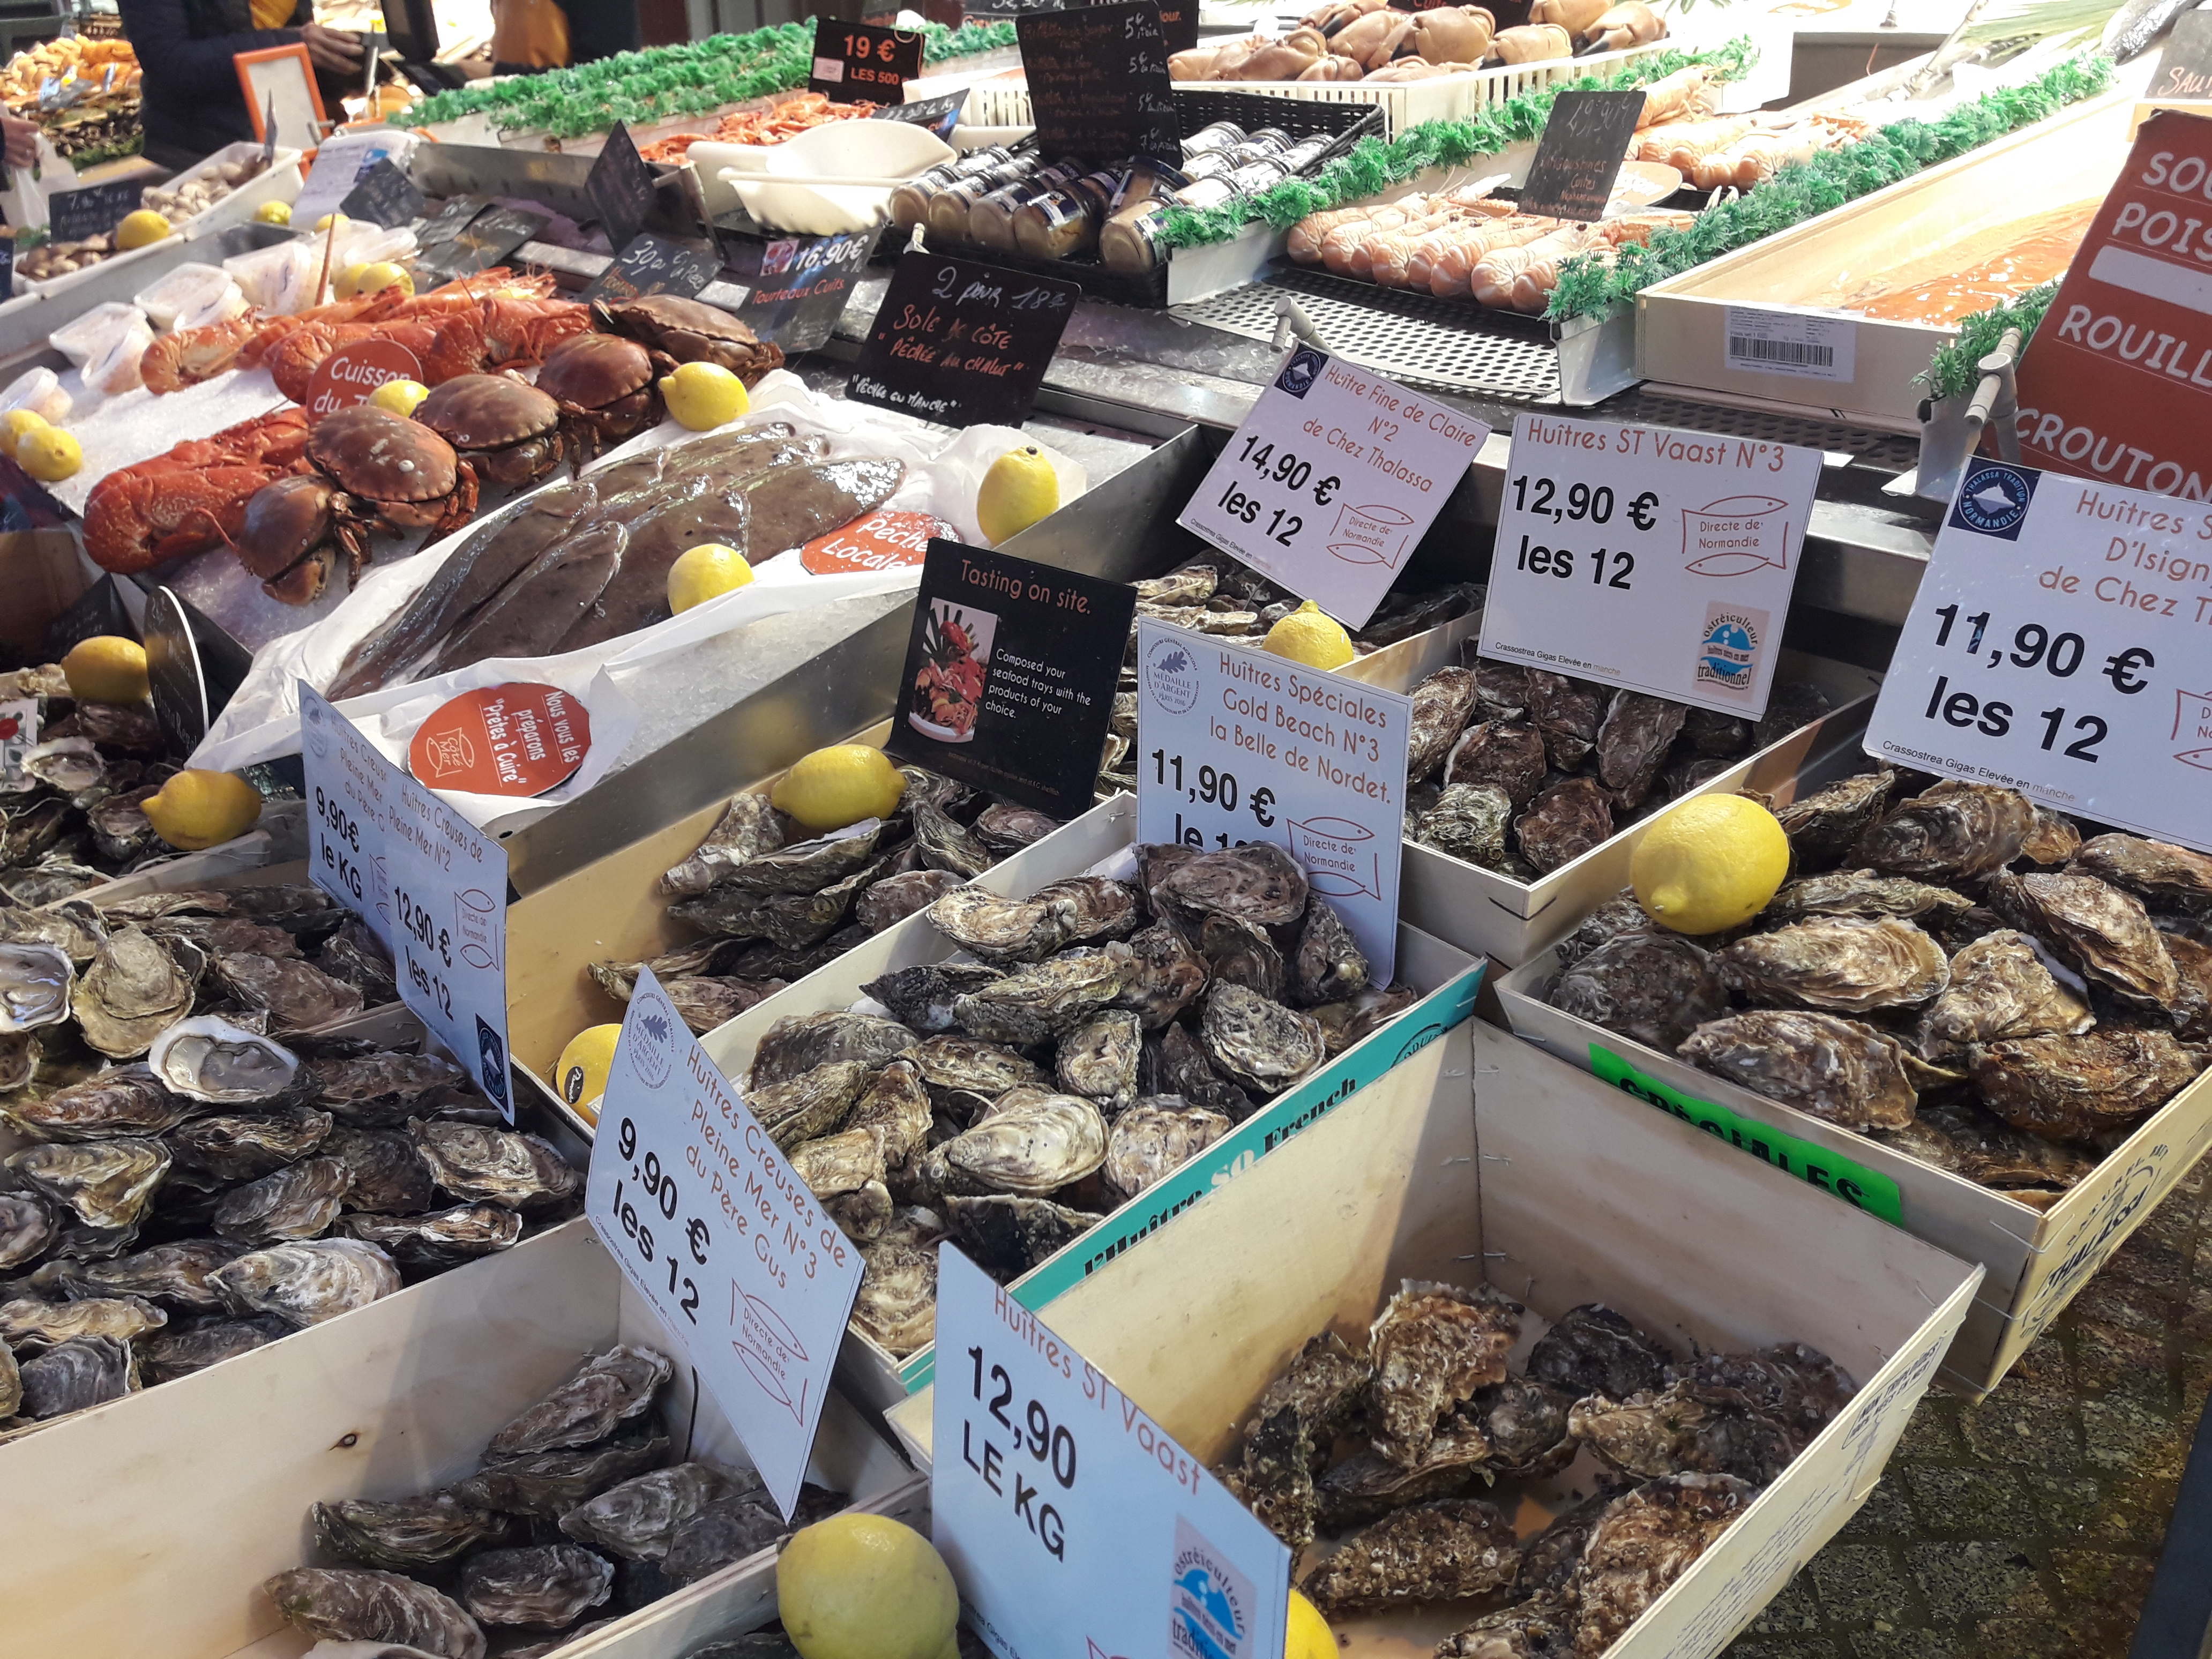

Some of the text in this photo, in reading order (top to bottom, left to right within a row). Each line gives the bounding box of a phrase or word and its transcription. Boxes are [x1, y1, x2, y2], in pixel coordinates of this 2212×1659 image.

[844, 34, 896, 62] 19 €
[850, 67, 900, 86] LES 500
[795, 235, 869, 272] 16,90€
[814, 278, 845, 295] Cuits
[932, 266, 958, 299] 2
[314, 388, 341, 413] du
[1325, 364, 1363, 396] Huître
[1368, 385, 1400, 412] Fine
[1402, 402, 1424, 424] de
[1429, 412, 1477, 447] Claire
[1302, 418, 1433, 492] de Chez Thalassa
[1367, 415, 1399, 443] N°2
[1527, 417, 1785, 473] Huîtres ST Vaast N°3
[1239, 435, 1340, 506] 14,90 €
[1966, 471, 1999, 493] THALASSA
[1217, 481, 1303, 547] les 12
[1348, 515, 1392, 536] Directe de
[1513, 475, 1660, 531] 12,90 €
[1700, 520, 1740, 532] Directe
[1962, 501, 2019, 528] NORMANDIE
[2075, 490, 2184, 534] Huîtres
[1342, 528, 1385, 548] Normandie
[1517, 535, 1635, 590] les 12
[1699, 536, 1760, 550] Normandie
[961, 559, 1092, 615] Tasting on site.
[2039, 566, 2178, 616] de Chez
[996, 648, 1066, 680] Composed your
[1495, 642, 1535, 658] Crassostrea
[1537, 649, 1557, 663] Gigas
[1558, 654, 1582, 668] Elevée
[1582, 661, 1592, 670] en
[1698, 662, 1752, 685] traditionnel
[1934, 603, 2155, 694] 11,90 €
[985, 700, 1017, 719] choice.
[988, 684, 1062, 715] products of your
[992, 667, 1092, 707] seafood trays with the
[1154, 681, 1191, 699] D'ARGENT
[1219, 651, 1282, 693] Huîtres
[1288, 674, 1387, 729] Spéciales
[331, 714, 359, 753] Huîtres
[511, 708, 547, 761] préparons
[544, 691, 581, 763] Nous vous les
[1222, 687, 1268, 723] Gold
[1276, 705, 1335, 747] Beach
[1343, 729, 1380, 763] N°3
[1925, 675, 2109, 764] les 12
[340, 747, 382, 804] Pleine Mer
[439, 741, 451, 766] Mer
[447, 737, 464, 767] Côté
[1210, 715, 1392, 804] la Belle de Nordet.
[1882, 740, 2076, 803] Crassostrea Gigas Elevée en manche
[345, 780, 355, 799] du
[1151, 749, 1276, 828] 11,90 €
[316, 786, 360, 853] 9,90€
[389, 804, 452, 872] Pleine Mer N°2
[402, 783, 483, 863] Huîtres Creuses de
[1303, 834, 1356, 855] Directe de
[321, 833, 334, 870] le
[339, 851, 362, 902] KG
[1304, 851, 1356, 873] Normandie
[394, 886, 434, 952] 12,90
[438, 928, 452, 969] €
[405, 945, 431, 997] les
[432, 975, 454, 1022] 12
[686, 1044, 847, 1268] Huîtres Creuses de
[618, 1117, 678, 1221] 9,90
[685, 1217, 711, 1266] €
[690, 1098, 818, 1279] Pleine Mer N°3
[685, 1145, 788, 1290] du Père Gus
[612, 1178, 699, 1326] les 12
[741, 1322, 786, 1380] Normandie
[743, 1306, 774, 1346] Directe
[968, 1345, 1077, 1490] 12,90
[993, 1286, 1202, 1496] Huîtres ST Vaast
[963, 1418, 1065, 1564] LE KG
